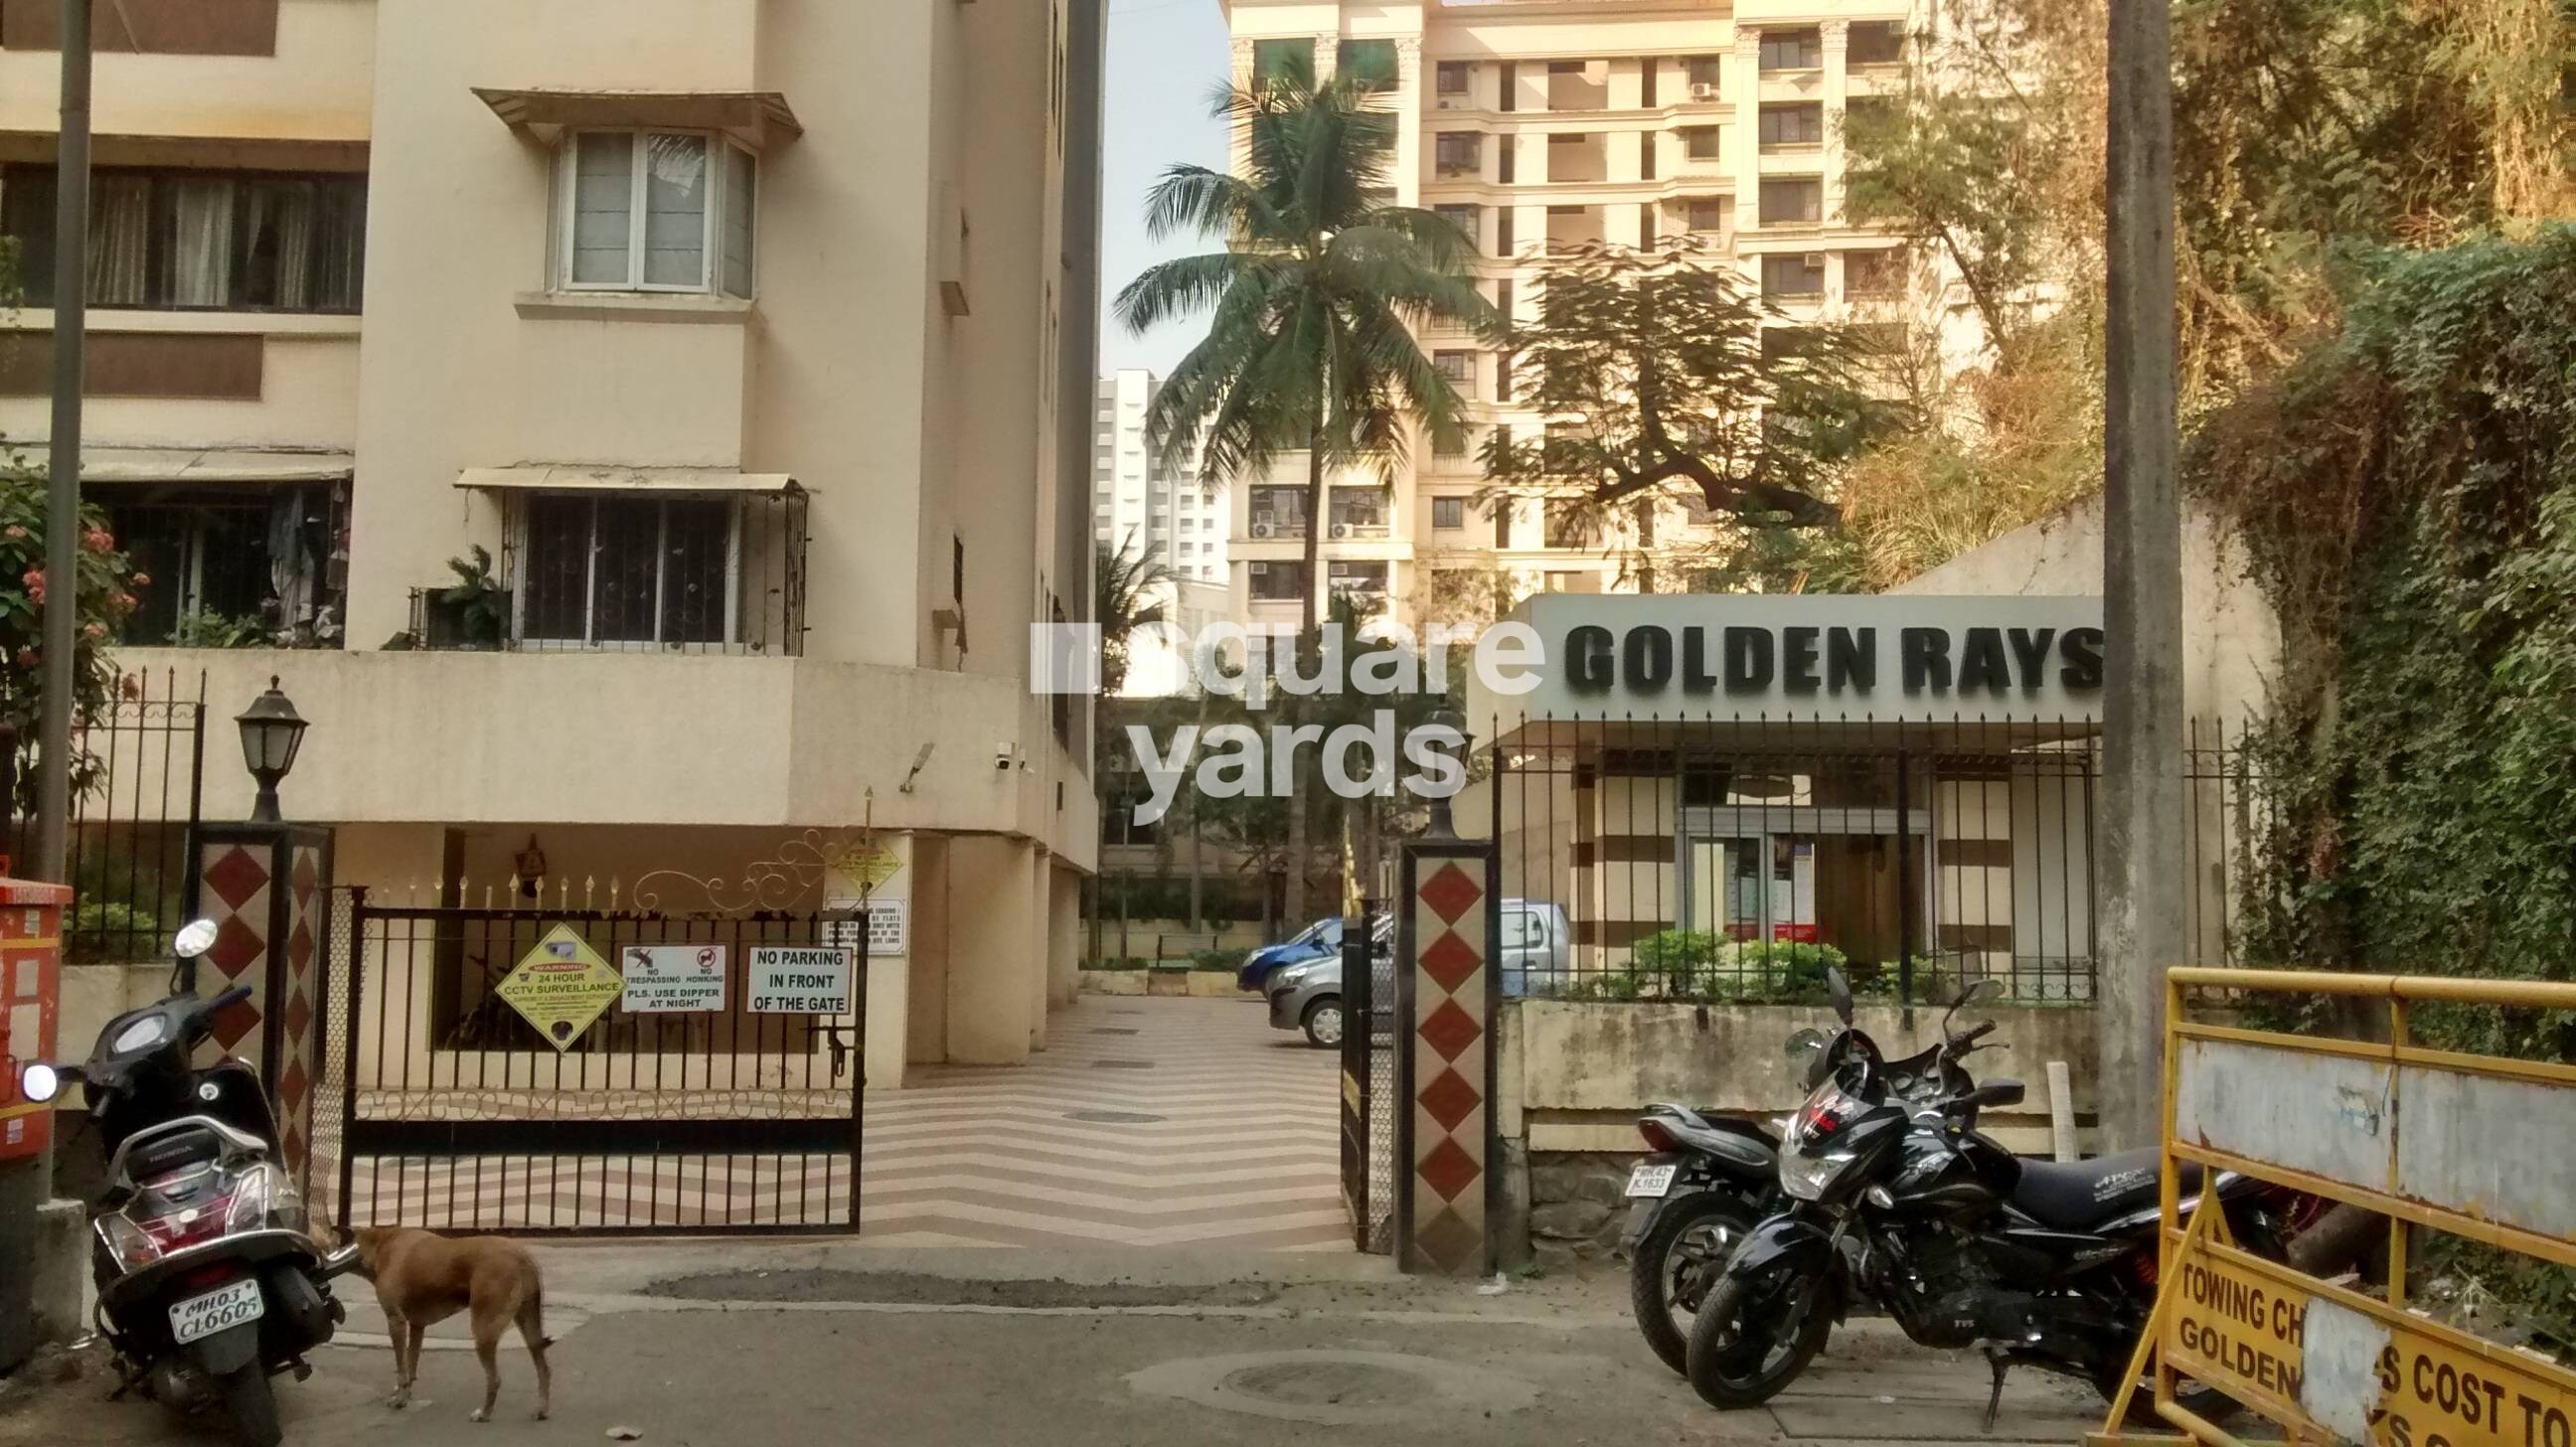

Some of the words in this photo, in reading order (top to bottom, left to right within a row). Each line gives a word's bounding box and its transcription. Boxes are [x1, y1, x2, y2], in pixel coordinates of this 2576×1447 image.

[1563, 625, 1877, 694] GOLDEN
[1900, 626, 2105, 693] RAYS
[757, 951, 777, 964] NO
[781, 951, 844, 965] PARKING
[533, 963, 588, 972] WARNING
[538, 974, 550, 983] 24
[554, 973, 584, 983] HOUR
[626, 975, 681, 984] TRESPASSING
[769, 974, 784, 988] IN
[788, 974, 835, 988] FRONT
[504, 985, 534, 995] CCTV
[537, 982, 619, 994] SURVEILLANCE
[666, 999, 702, 1008] NIGHT
[754, 997, 772, 1010] OF
[776, 997, 804, 1011] THE
[808, 997, 845, 1011] GATE
[2179, 1317, 2304, 1404] GOLDEN
[2183, 1262, 2265, 1330] TOWING
[2413, 1354, 2506, 1435] COST
[2516, 1393, 2571, 1447] TO
